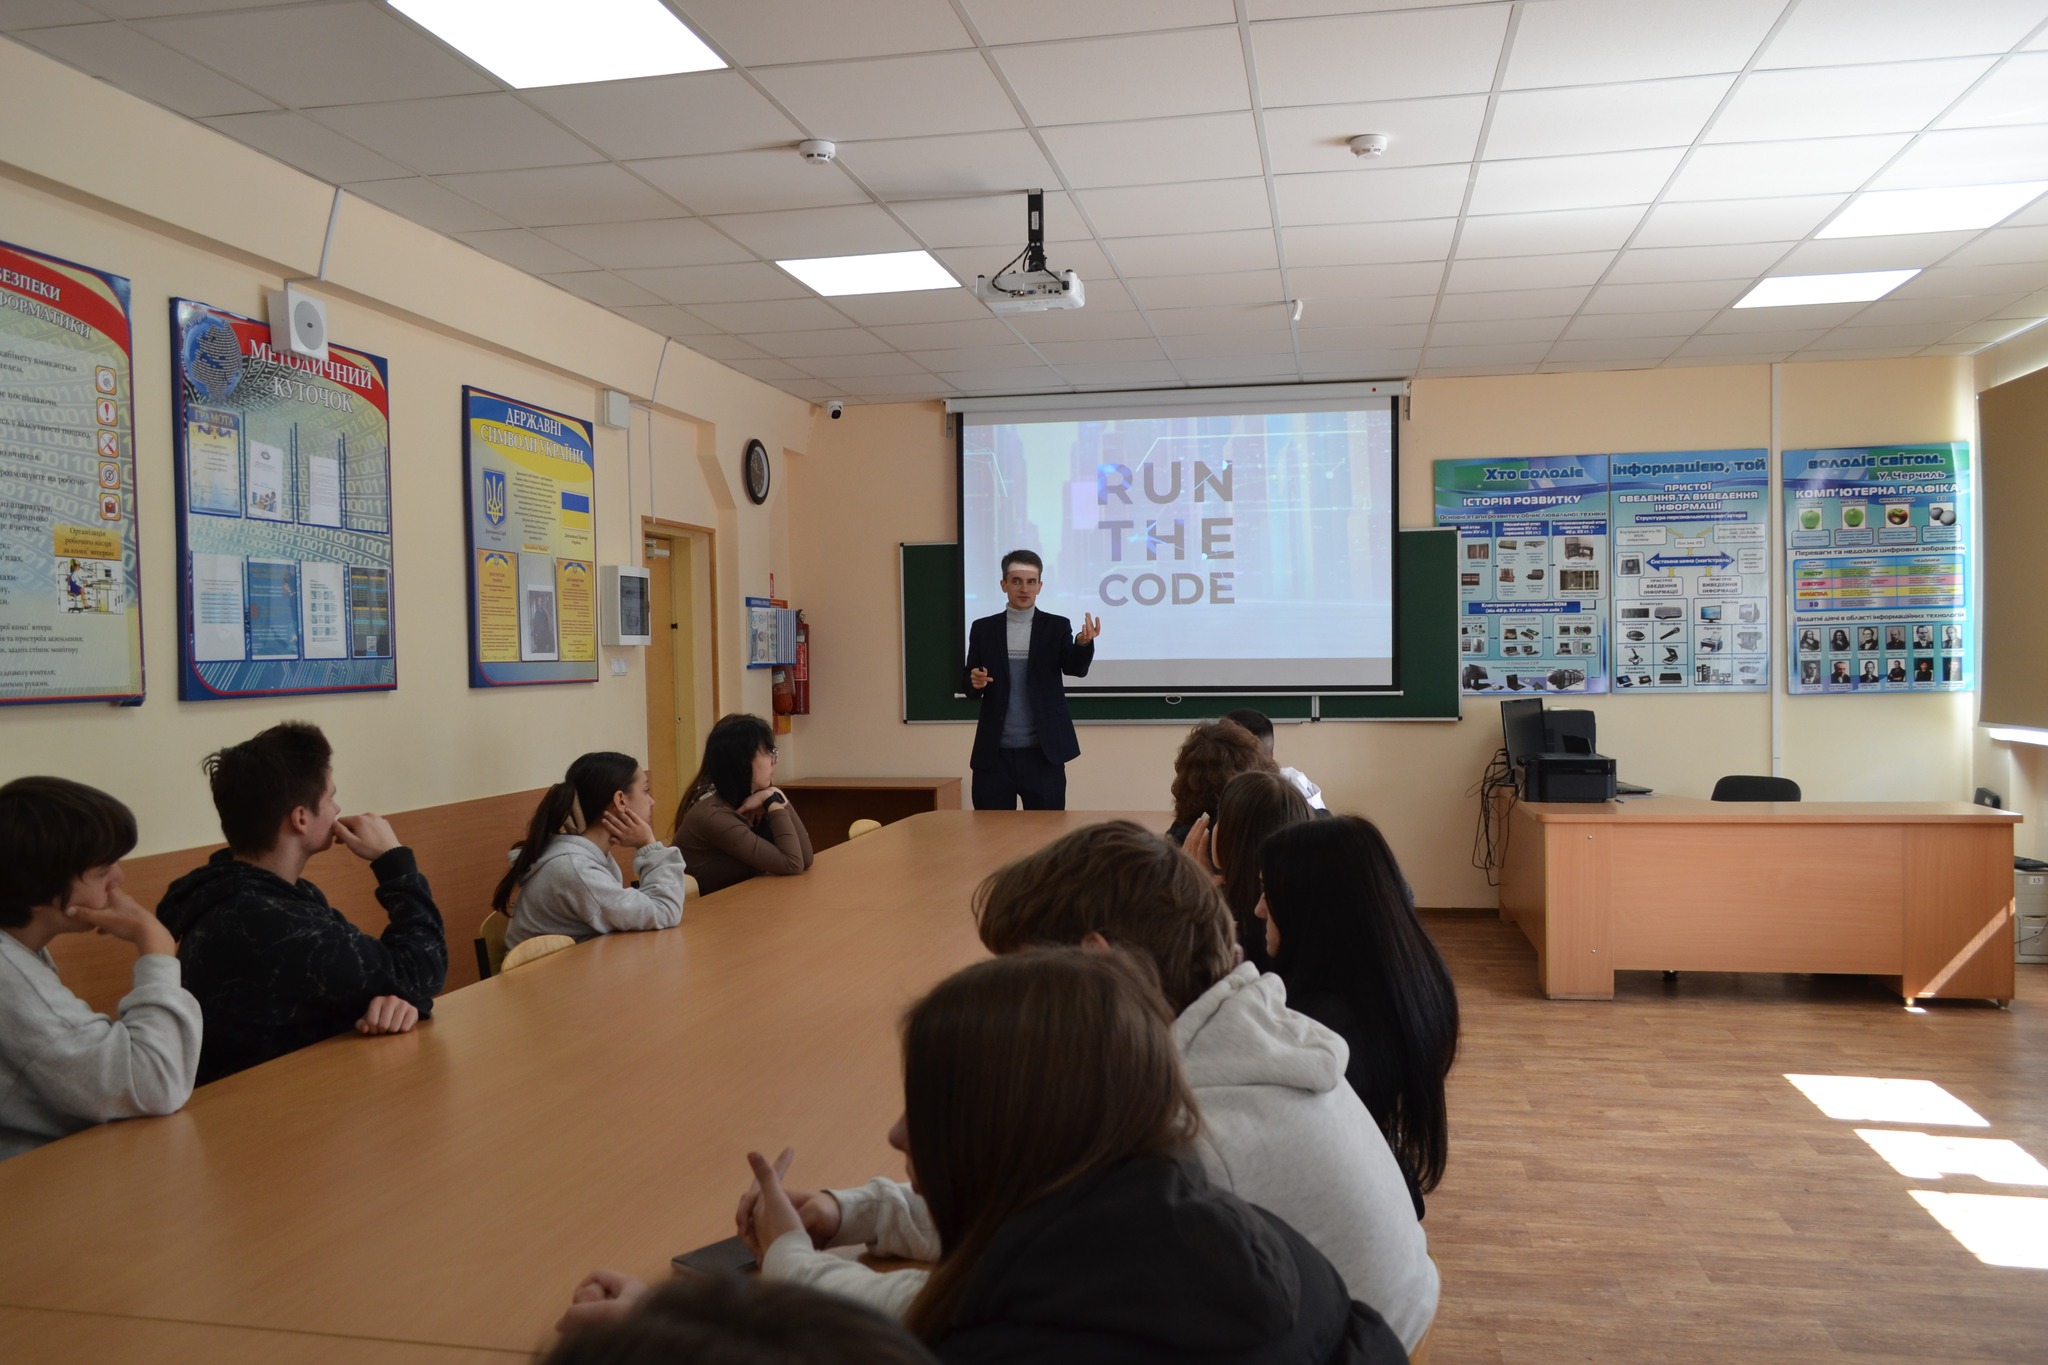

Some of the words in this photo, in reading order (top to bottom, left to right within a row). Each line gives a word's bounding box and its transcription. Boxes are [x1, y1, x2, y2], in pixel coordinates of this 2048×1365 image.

[272, 375, 353, 414] КУТОЧОК
[194, 409, 235, 428] ГРАМОТА
[506, 407, 562, 437] ДЕРЖАВНІ
[480, 423, 538, 454] СИМВОЛИ
[539, 439, 585, 465] УКРАЇНИ
[1612, 460, 1731, 478] інформацією,
[1734, 458, 1766, 471] той
[1808, 455, 1877, 470] володіє
[1878, 452, 1946, 467] світом.
[1097, 459, 1234, 506] RUN
[1484, 467, 1517, 481] Хто
[1519, 466, 1585, 480] володіє
[1878, 472, 1892, 482] У.
[1892, 470, 1946, 482] Черчиль
[1619, 494, 1676, 503] ВВЕДЕННЯ
[1692, 492, 1758, 501] ВИВЕДЕННЯ
[1898, 484, 1960, 494] ГРАФІКА
[1463, 497, 1512, 507] ІСТОРІЯ
[1514, 495, 1582, 506] РОЗВИТКУ
[1654, 502, 1722, 512] ІНФОРМАЦІЇ
[1097, 517, 1235, 562] THE
[1098, 571, 1236, 607] CODE
